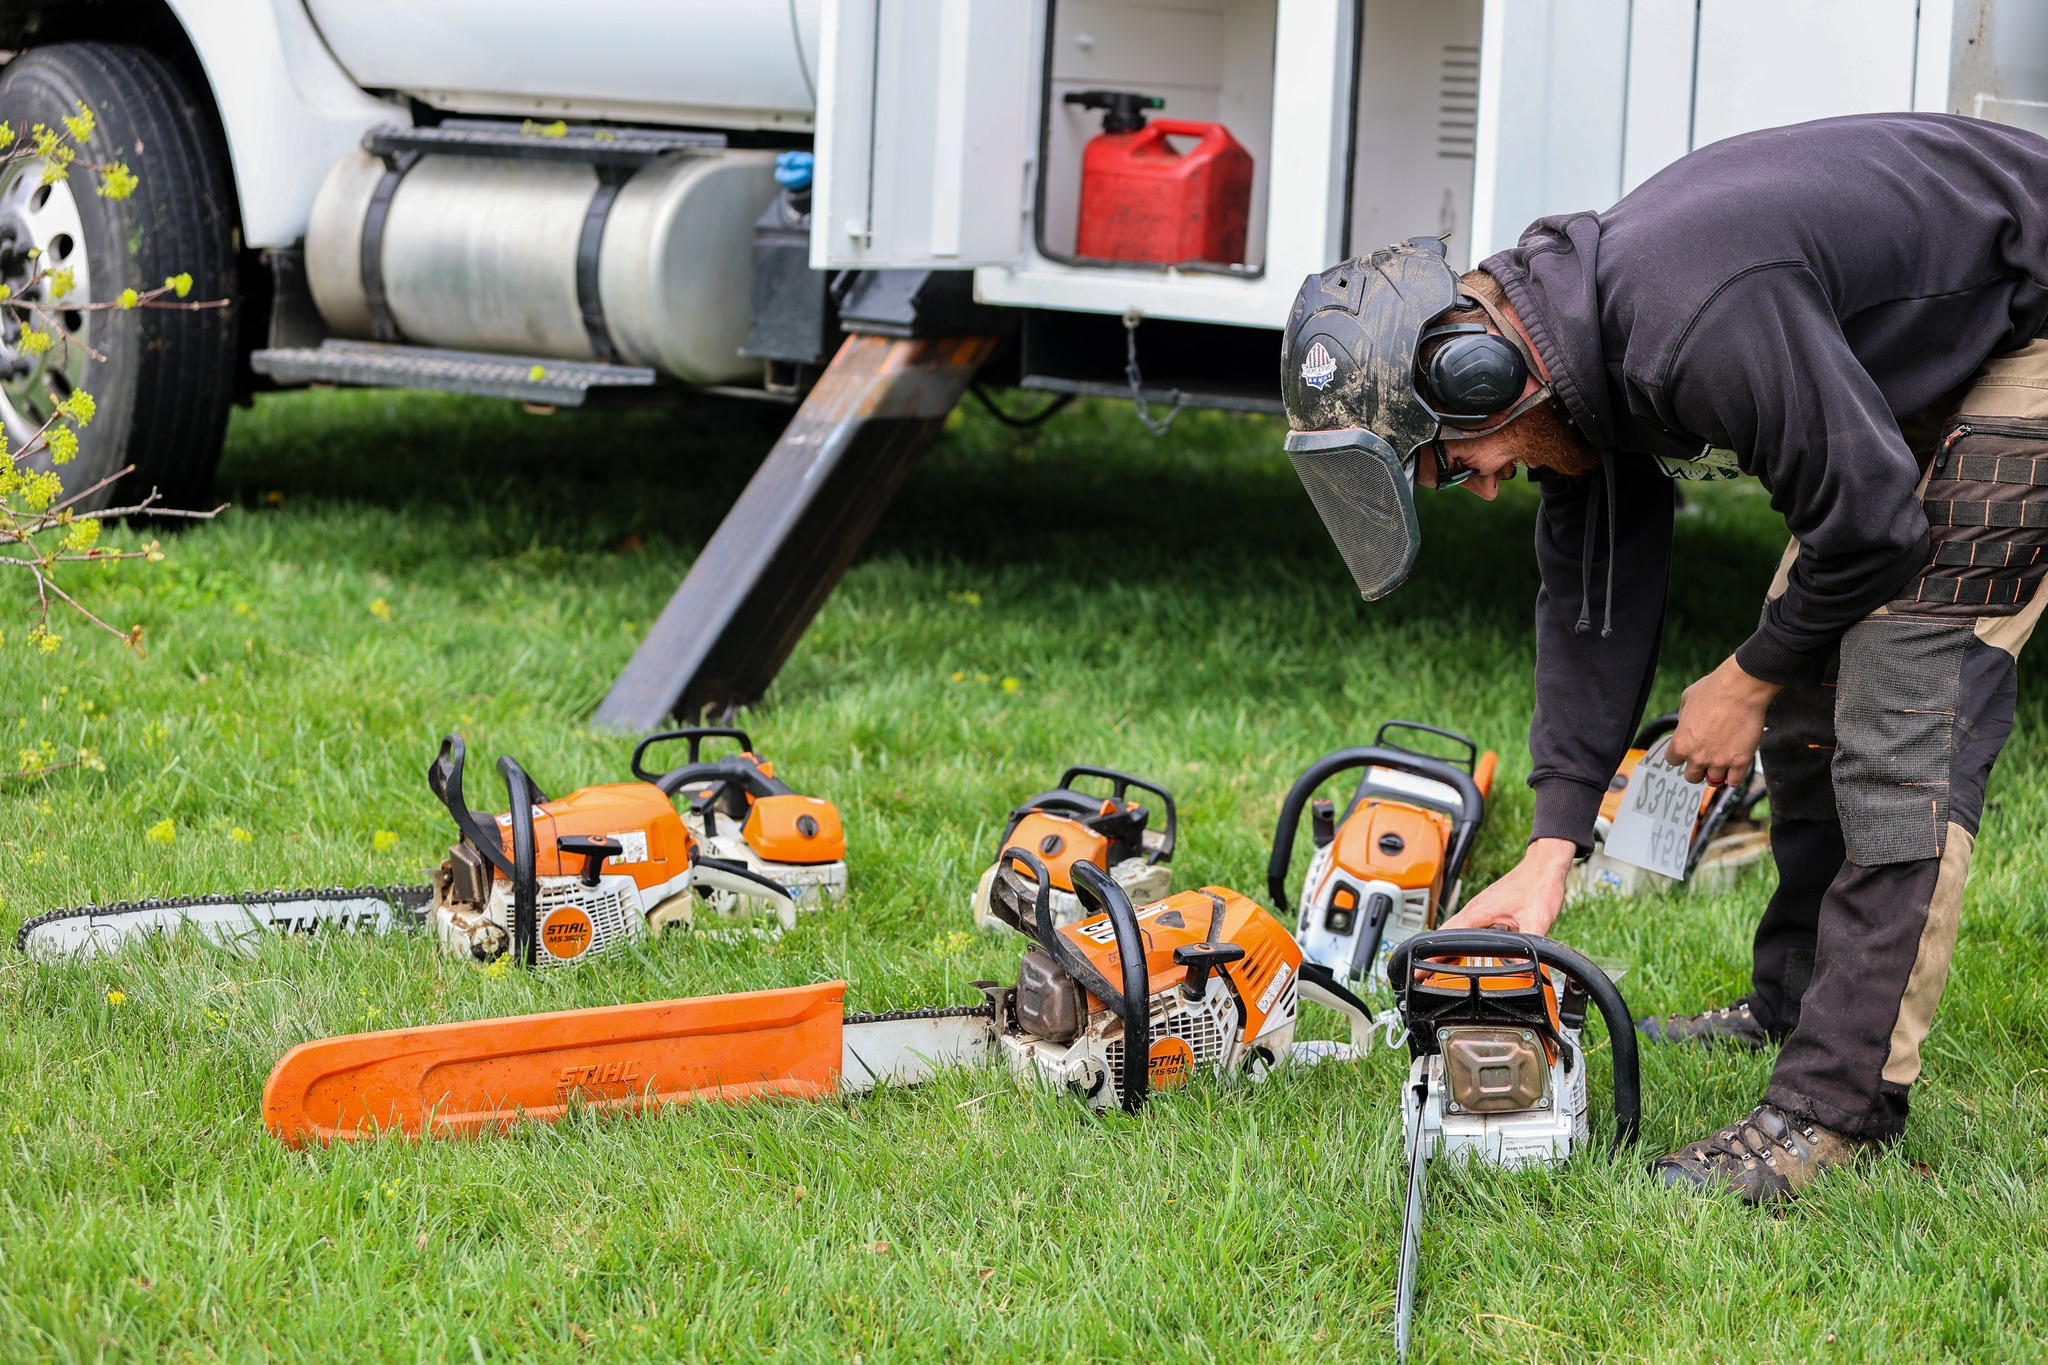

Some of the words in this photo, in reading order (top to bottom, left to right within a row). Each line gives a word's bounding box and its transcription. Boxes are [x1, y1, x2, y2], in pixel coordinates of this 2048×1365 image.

[546, 922, 587, 935] STIHL
[548, 935, 563, 943] MS
[1148, 1053, 1189, 1068] STIHL
[557, 1060, 639, 1088] STIHL
